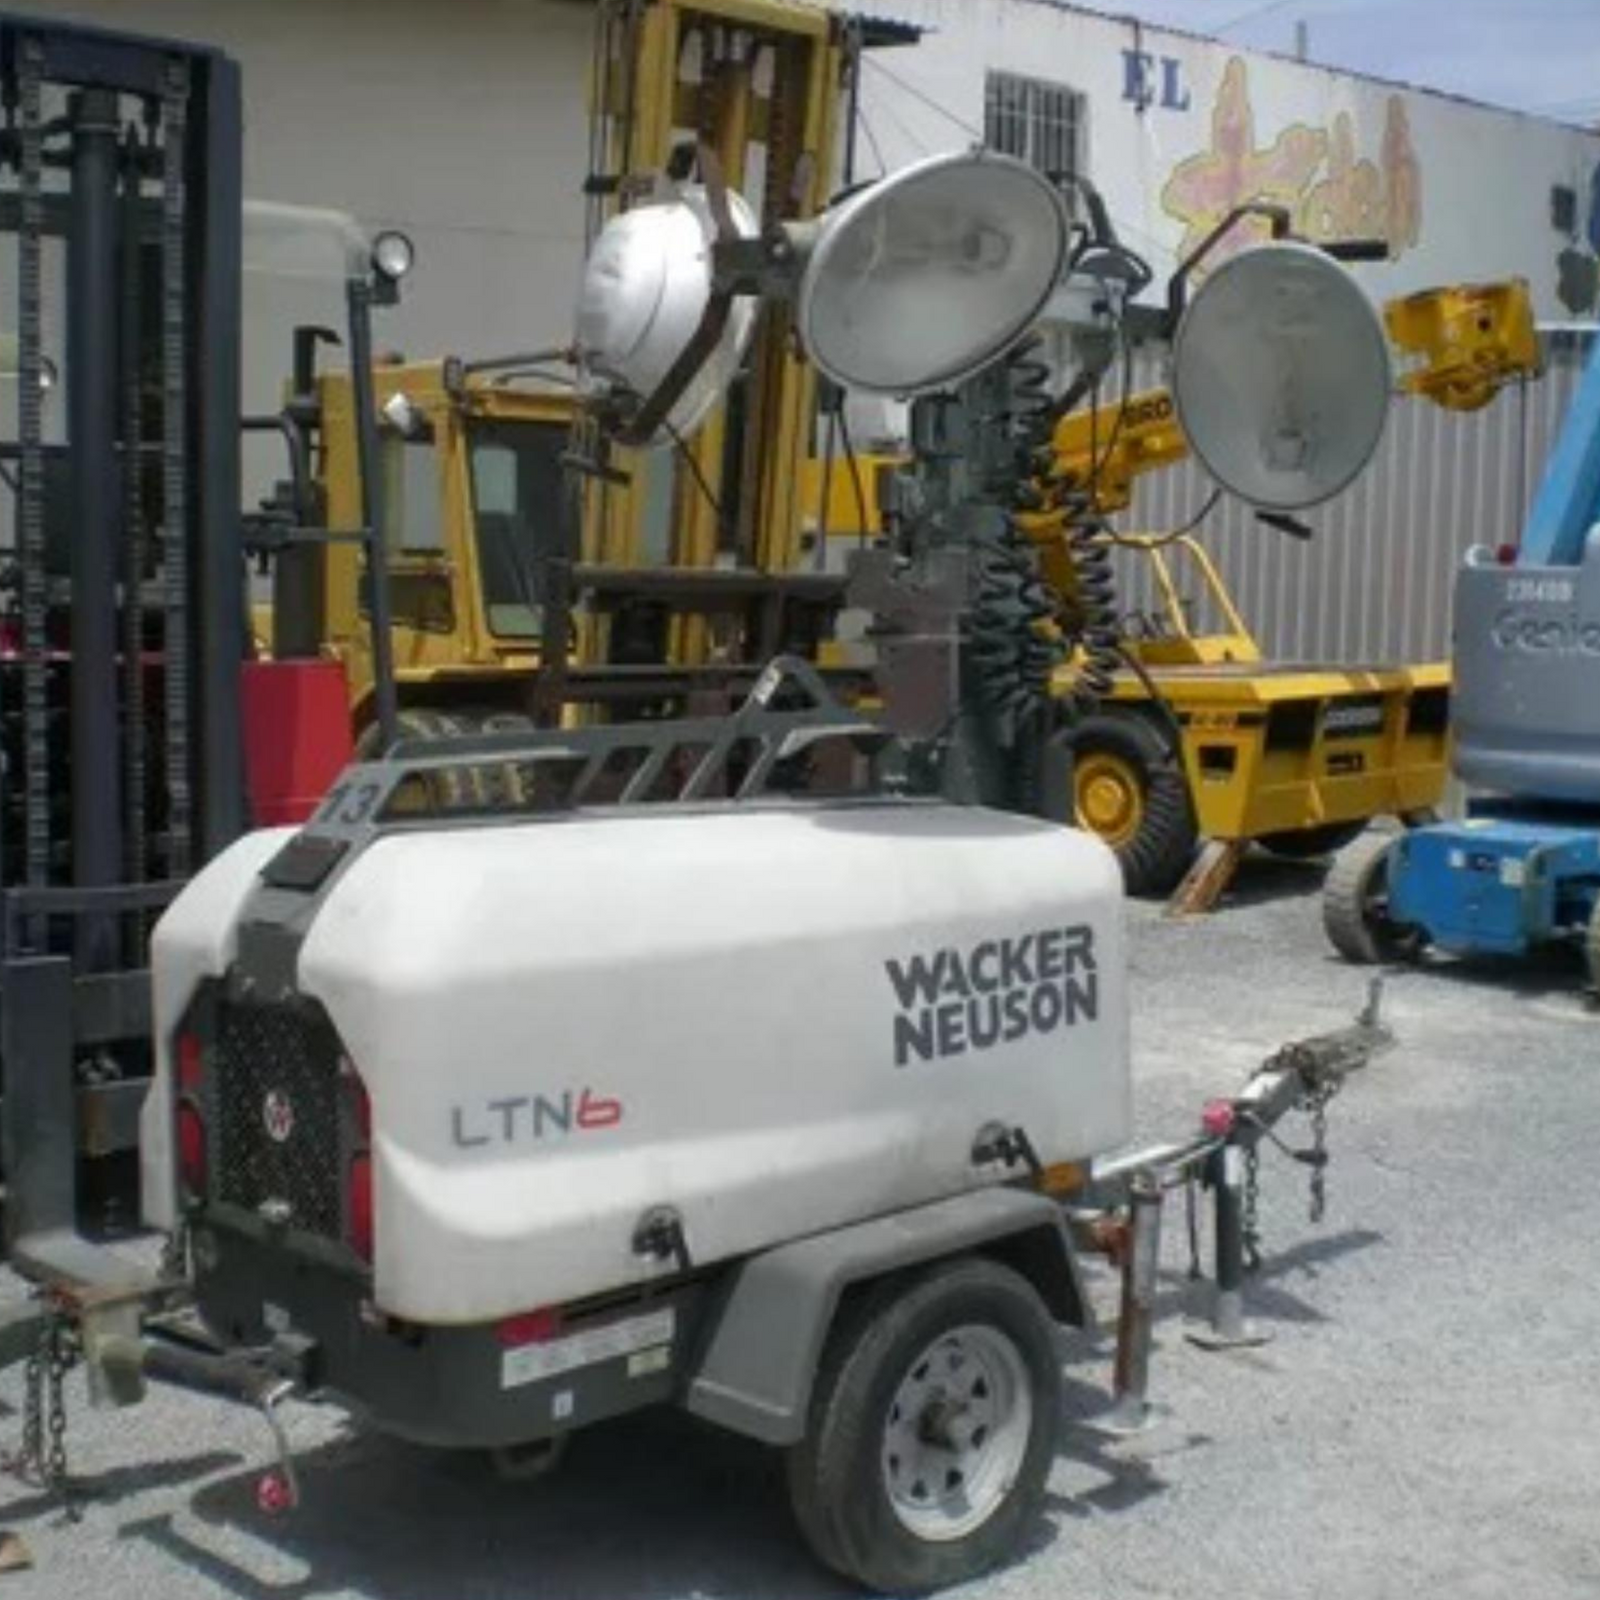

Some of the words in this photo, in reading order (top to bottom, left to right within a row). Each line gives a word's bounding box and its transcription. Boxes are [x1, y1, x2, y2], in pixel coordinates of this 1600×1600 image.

[1120, 49, 1191, 111] EL
[885, 924, 1096, 1008] WACKER
[894, 971, 1097, 1066] NEUSON
[452, 1087, 622, 1149] LTN6
